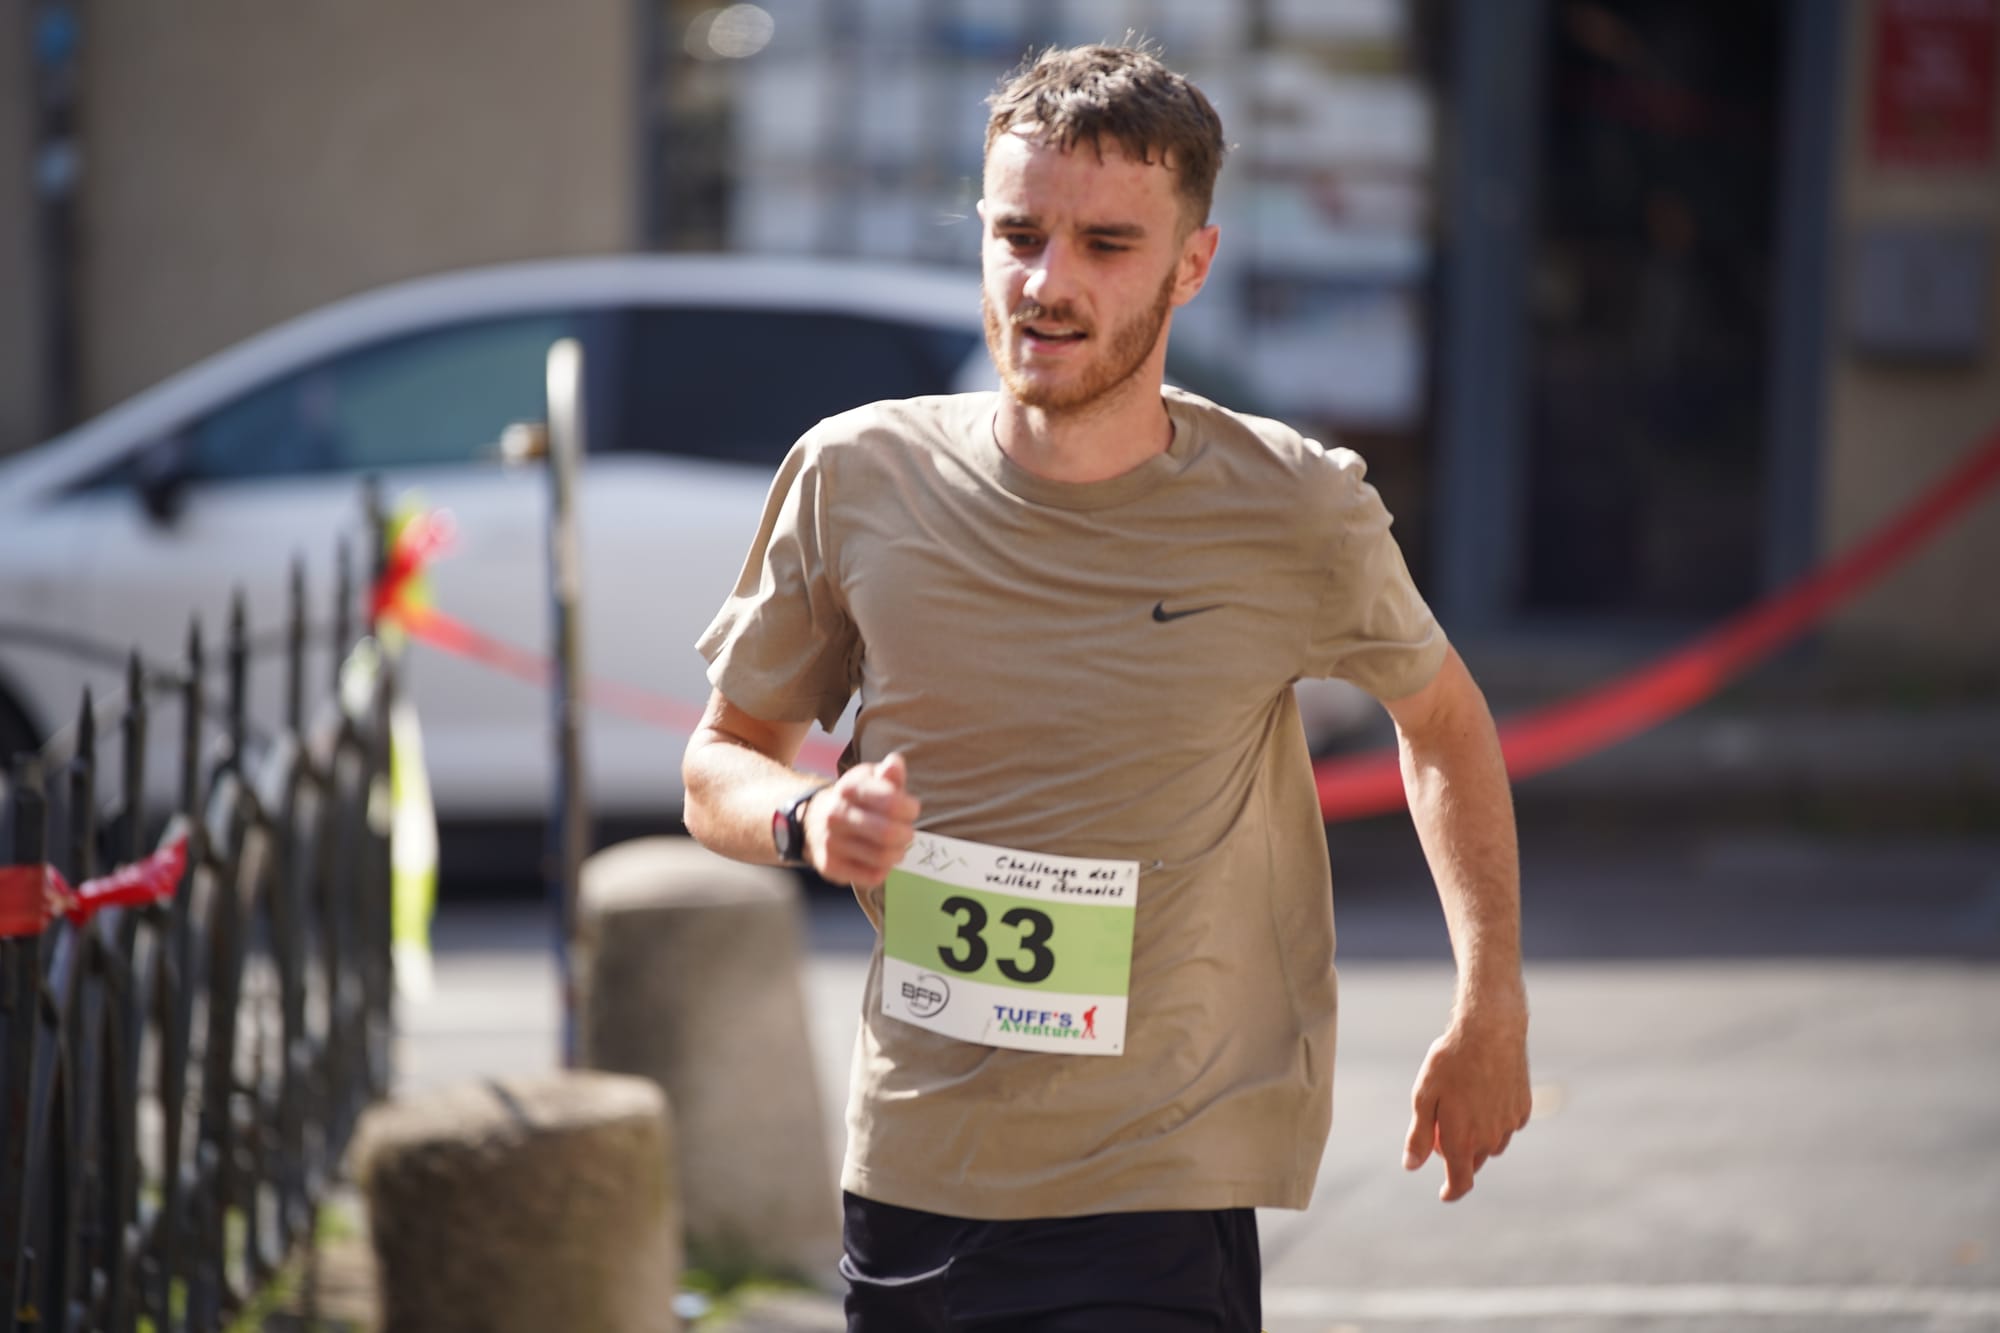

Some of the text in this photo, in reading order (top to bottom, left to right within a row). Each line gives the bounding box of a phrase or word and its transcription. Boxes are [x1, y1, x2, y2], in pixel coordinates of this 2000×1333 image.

[996, 856, 1117, 882] Challenge des
[937, 896, 1055, 983] 33
[902, 981, 942, 1005] BFP
[993, 1005, 1073, 1027] TUFF'S
